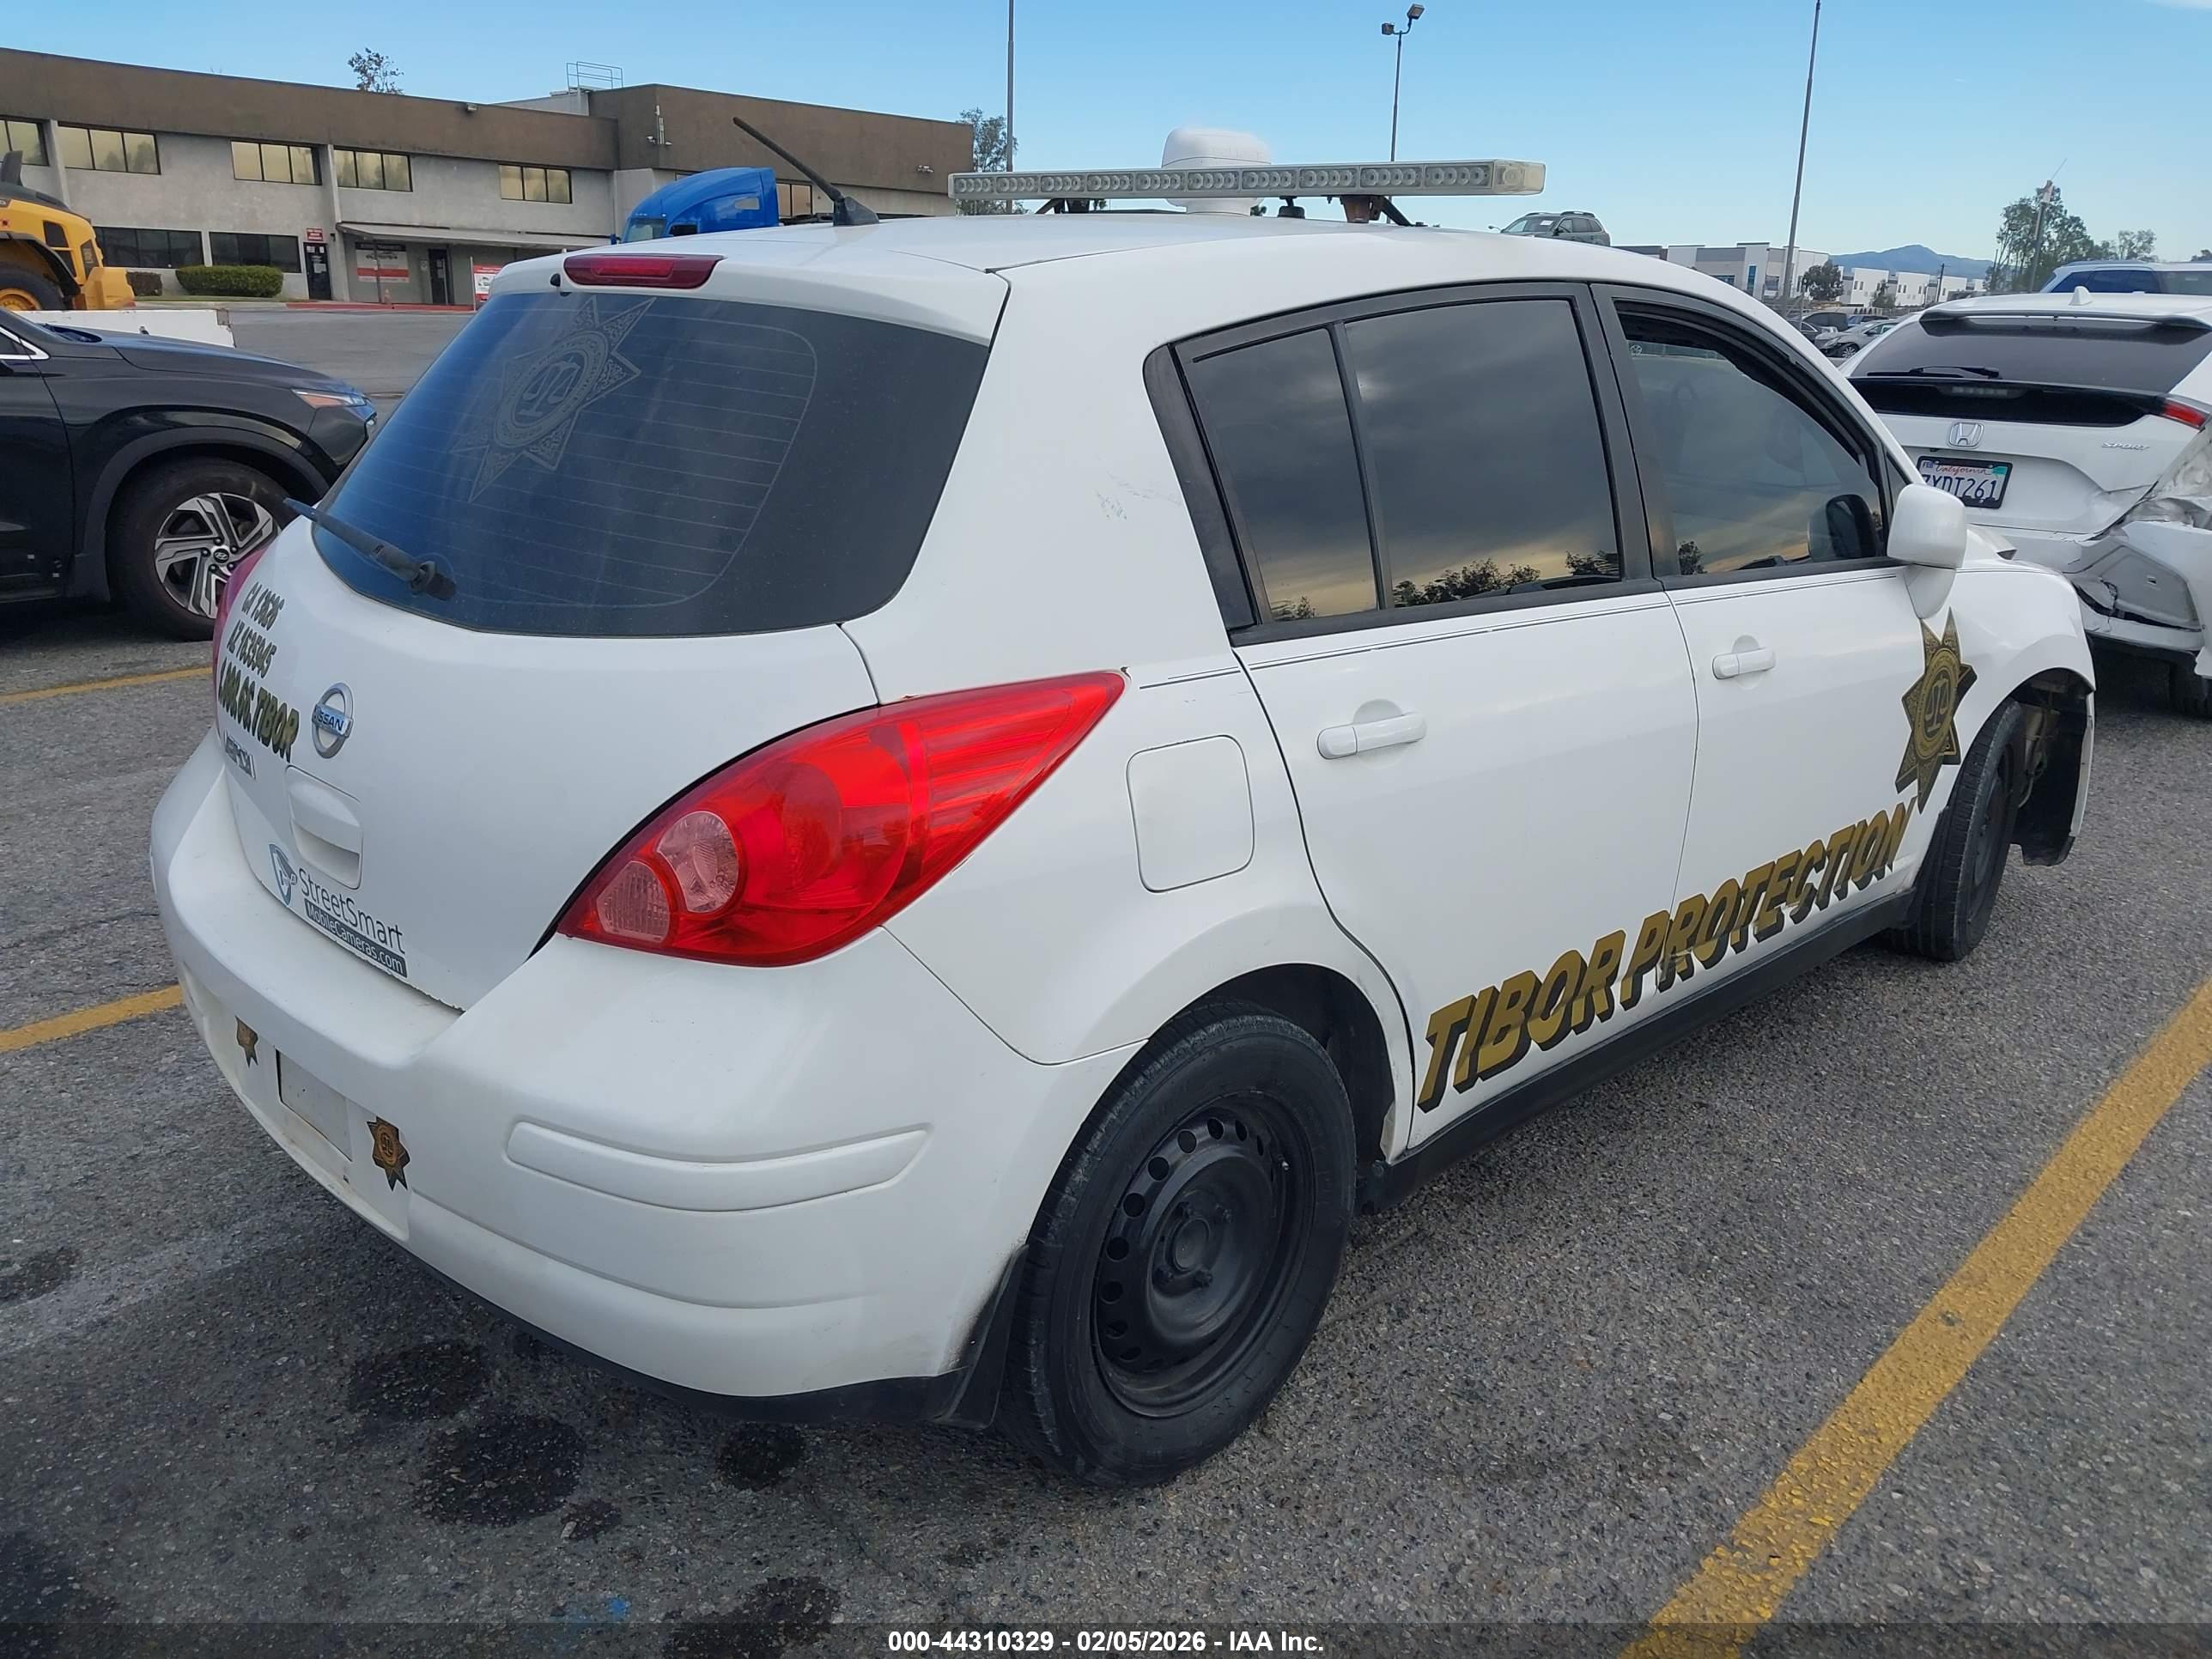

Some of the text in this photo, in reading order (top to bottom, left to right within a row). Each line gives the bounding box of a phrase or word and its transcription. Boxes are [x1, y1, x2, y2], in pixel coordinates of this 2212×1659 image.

[1935, 464, 1992, 476] California
[299, 867, 405, 955] StreetSmart
[307, 904, 404, 974] MobileCameras.com
[1417, 796, 1917, 1113] TIBOR PROTECTION
